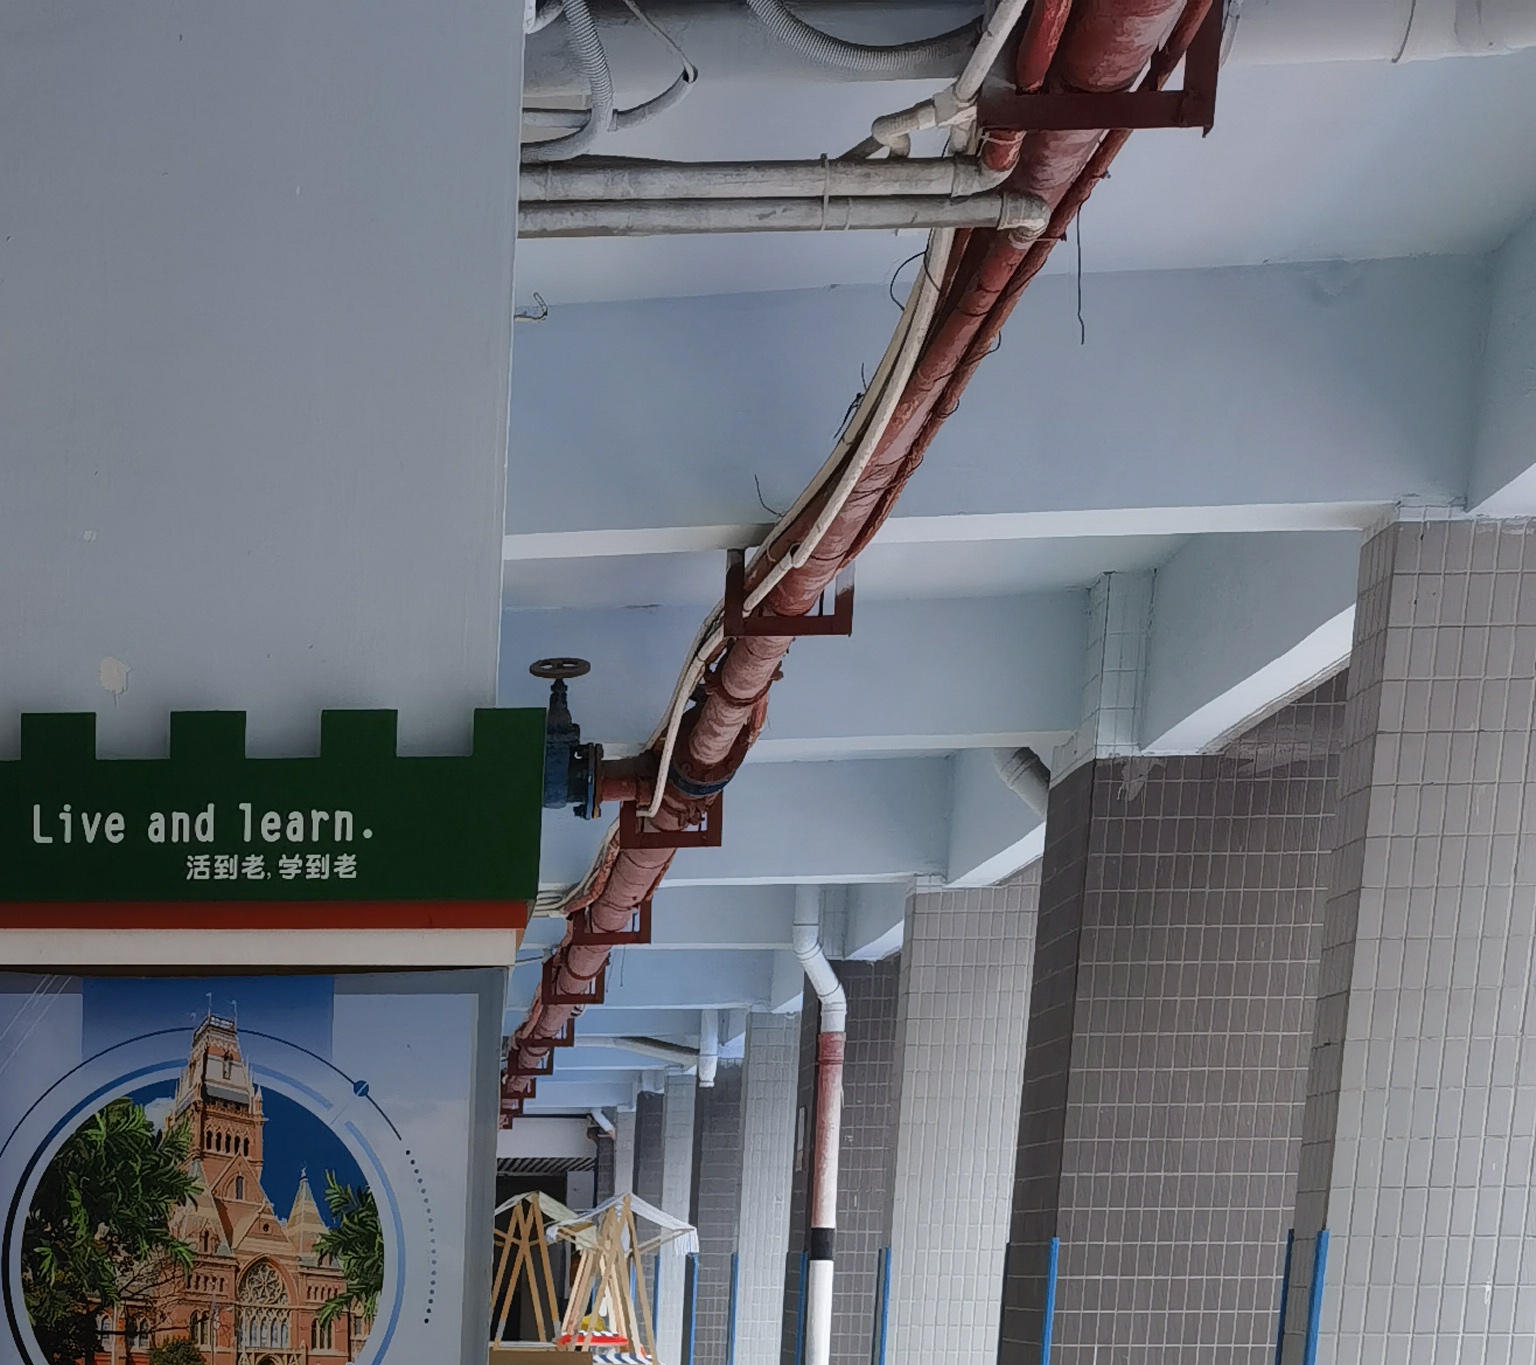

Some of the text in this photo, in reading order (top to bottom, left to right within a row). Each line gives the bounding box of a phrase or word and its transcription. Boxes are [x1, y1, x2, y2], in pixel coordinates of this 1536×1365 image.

[32, 804, 374, 844] Live and learn.
